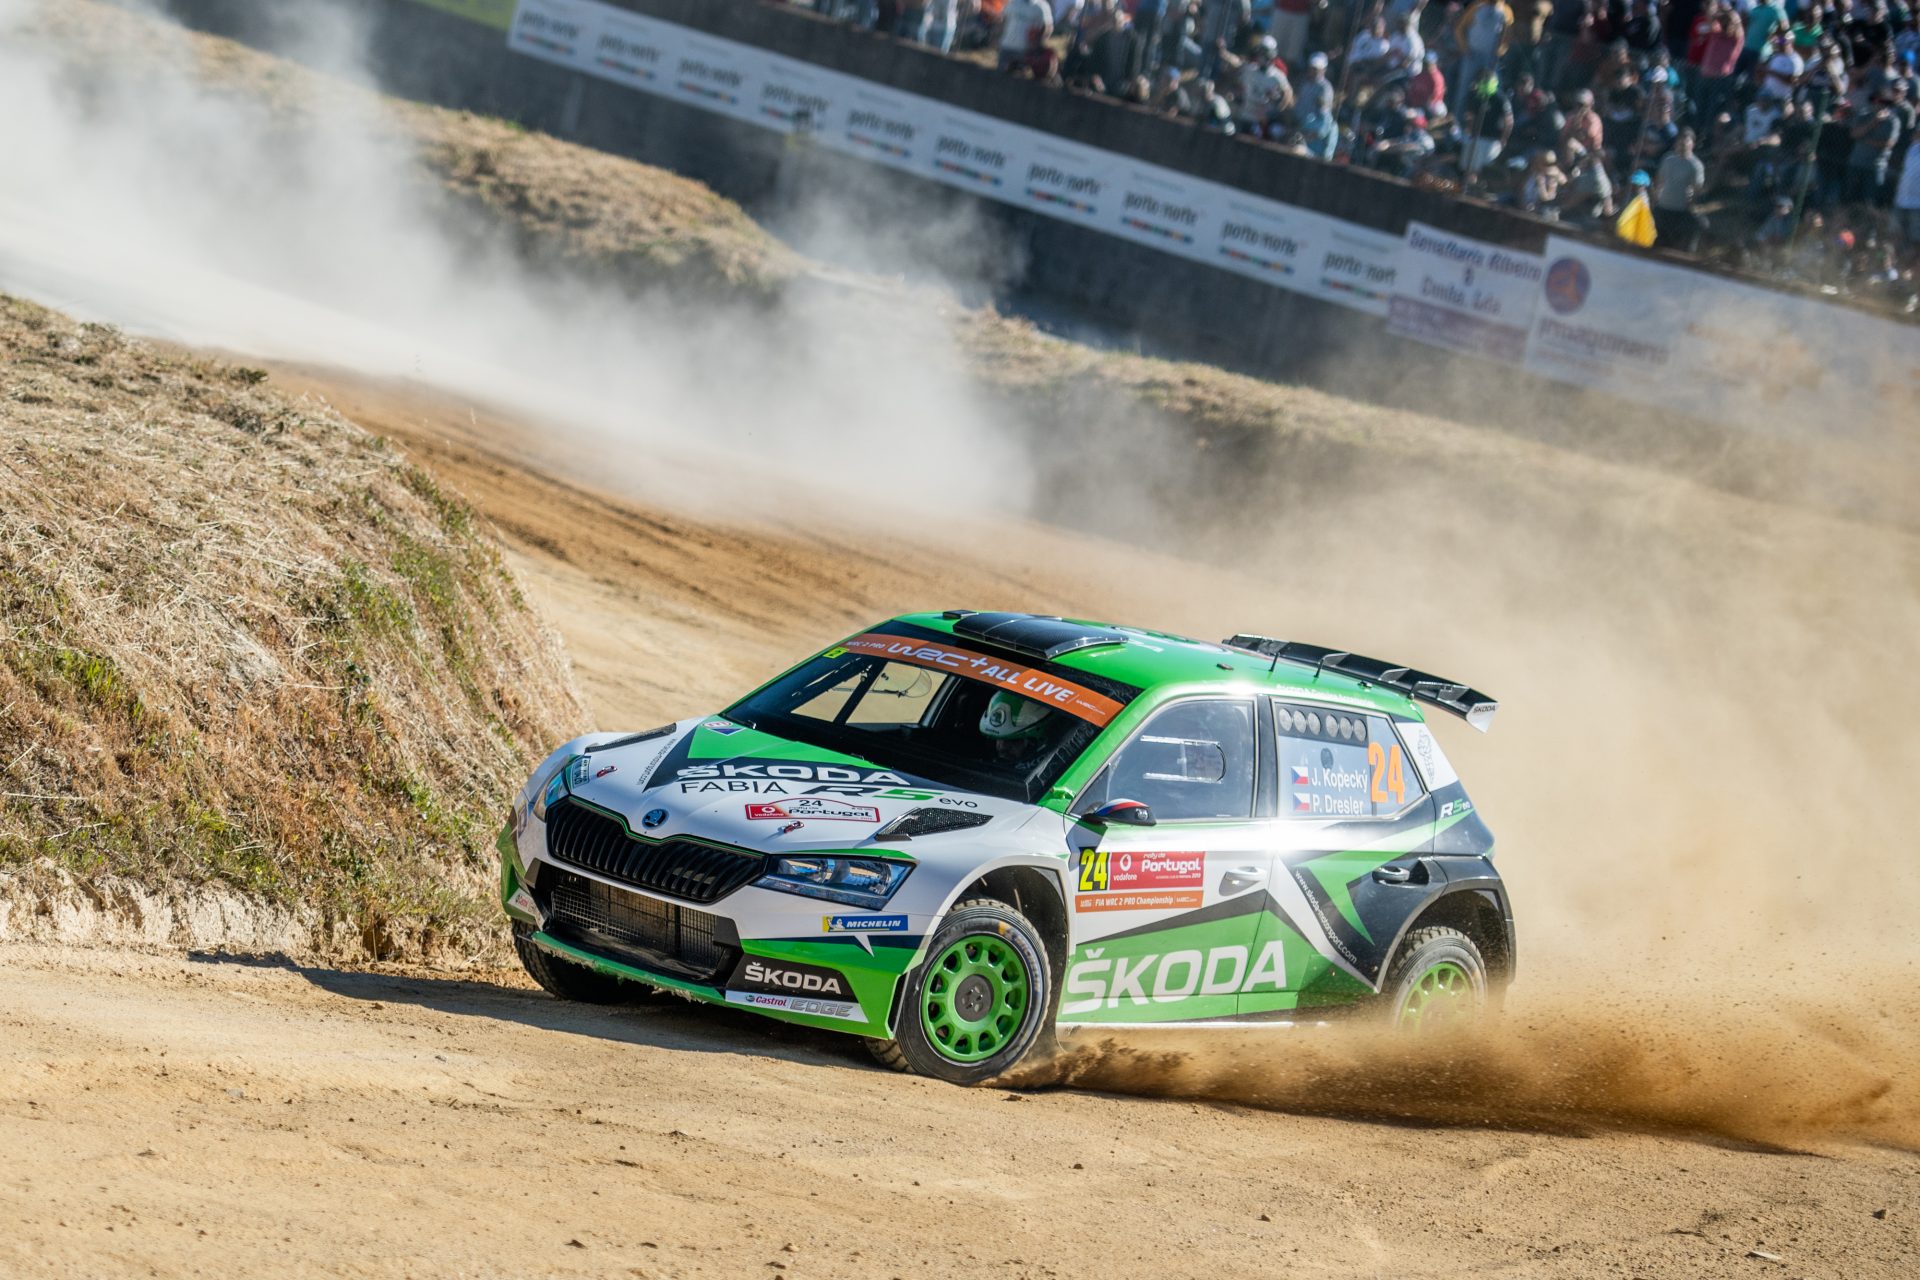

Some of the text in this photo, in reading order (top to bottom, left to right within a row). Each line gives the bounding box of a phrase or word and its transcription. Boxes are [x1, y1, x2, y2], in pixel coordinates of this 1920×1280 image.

[980, 664, 1021, 685] ALL
[1022, 677, 1075, 703] LIVE
[676, 764, 911, 786] ŠKODA
[1311, 768, 1369, 795] J. Kopecký
[1366, 742, 1406, 805] 24
[681, 780, 978, 809] FABIA R5 evo
[799, 799, 823, 807] 24
[788, 809, 872, 818] Portugal
[1313, 796, 1365, 816] P. Dresler
[1440, 798, 1463, 818] R5
[1080, 849, 1108, 890] 24
[1141, 859, 1201, 874] Portugal
[1113, 873, 1137, 881] vodafone
[1095, 898, 1105, 908] FIA
[1105, 898, 1118, 907] WRC
[1124, 896, 1136, 906] PRO
[1136, 896, 1174, 907] Championship
[846, 920, 901, 928] MICHELIN
[1295, 869, 1357, 965] www.skoda-motorsport.com
[744, 961, 842, 995] ŠKODA
[1061, 947, 1287, 1015] ŠKODA
[755, 995, 787, 1007] Castrol
[790, 999, 853, 1018] EDGE
